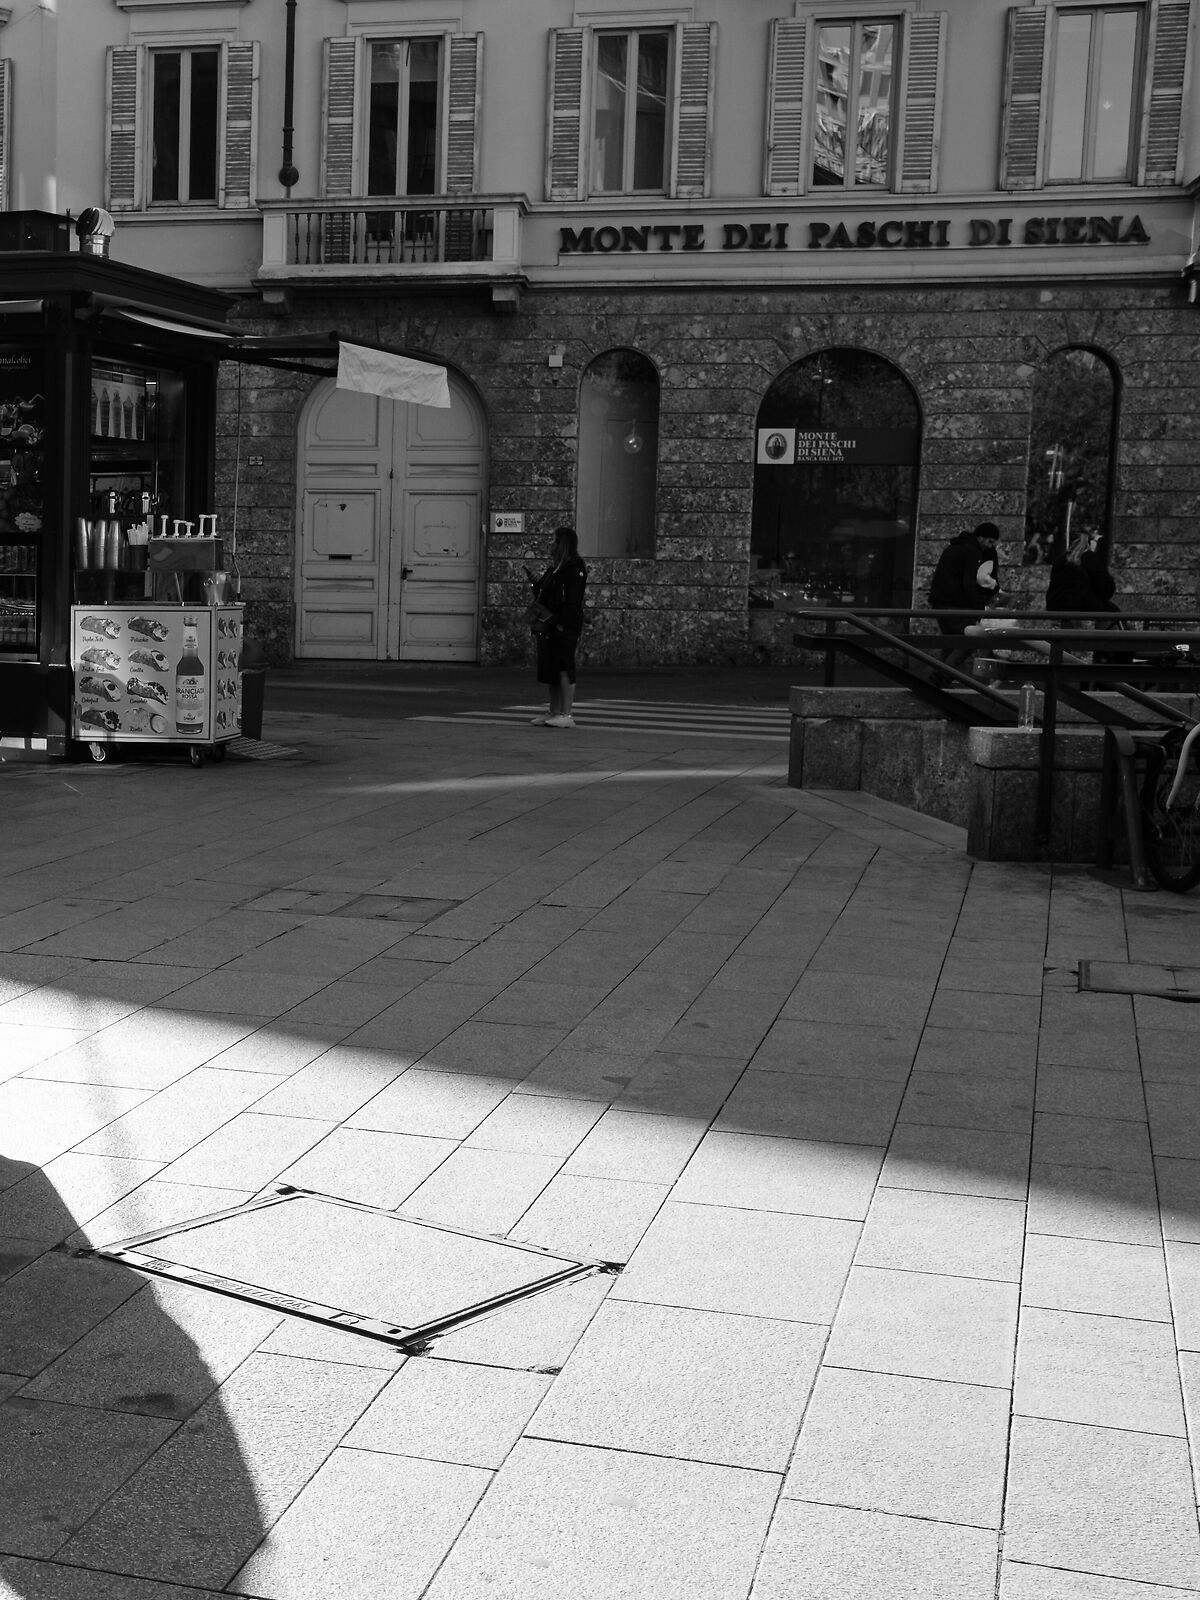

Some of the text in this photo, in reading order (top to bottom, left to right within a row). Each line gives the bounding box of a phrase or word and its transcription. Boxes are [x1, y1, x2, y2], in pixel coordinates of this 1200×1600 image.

[558, 214, 1151, 252] MONTE DEI PASCHI DI SIENA
[798, 432, 838, 440] MONTE
[798, 440, 857, 448] DEI PASCHI
[798, 448, 843, 456] DI SIENA
